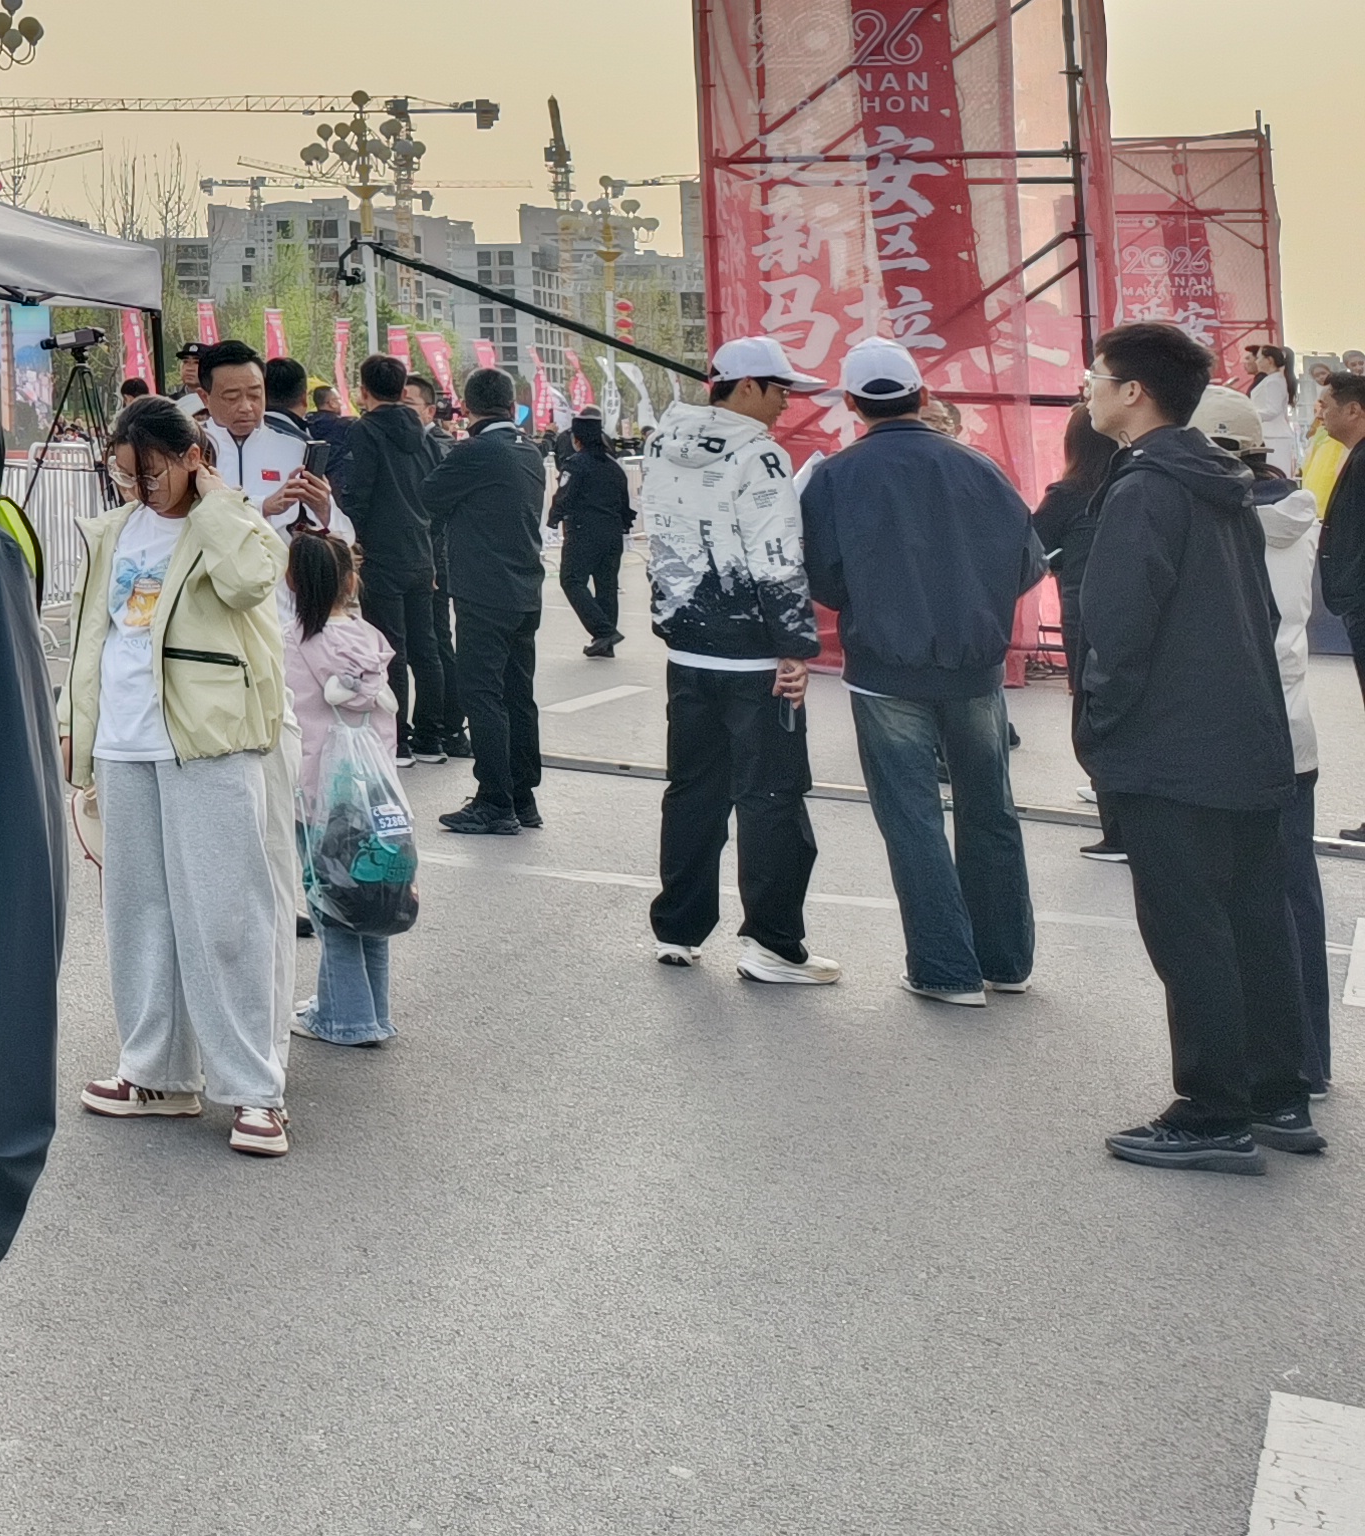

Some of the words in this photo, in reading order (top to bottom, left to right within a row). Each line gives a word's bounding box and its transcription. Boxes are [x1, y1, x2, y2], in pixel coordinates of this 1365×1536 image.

[1122, 245, 1211, 275] 2026
[1147, 275, 1212, 287] YANAN
[1122, 287, 1212, 297] MARATHON
